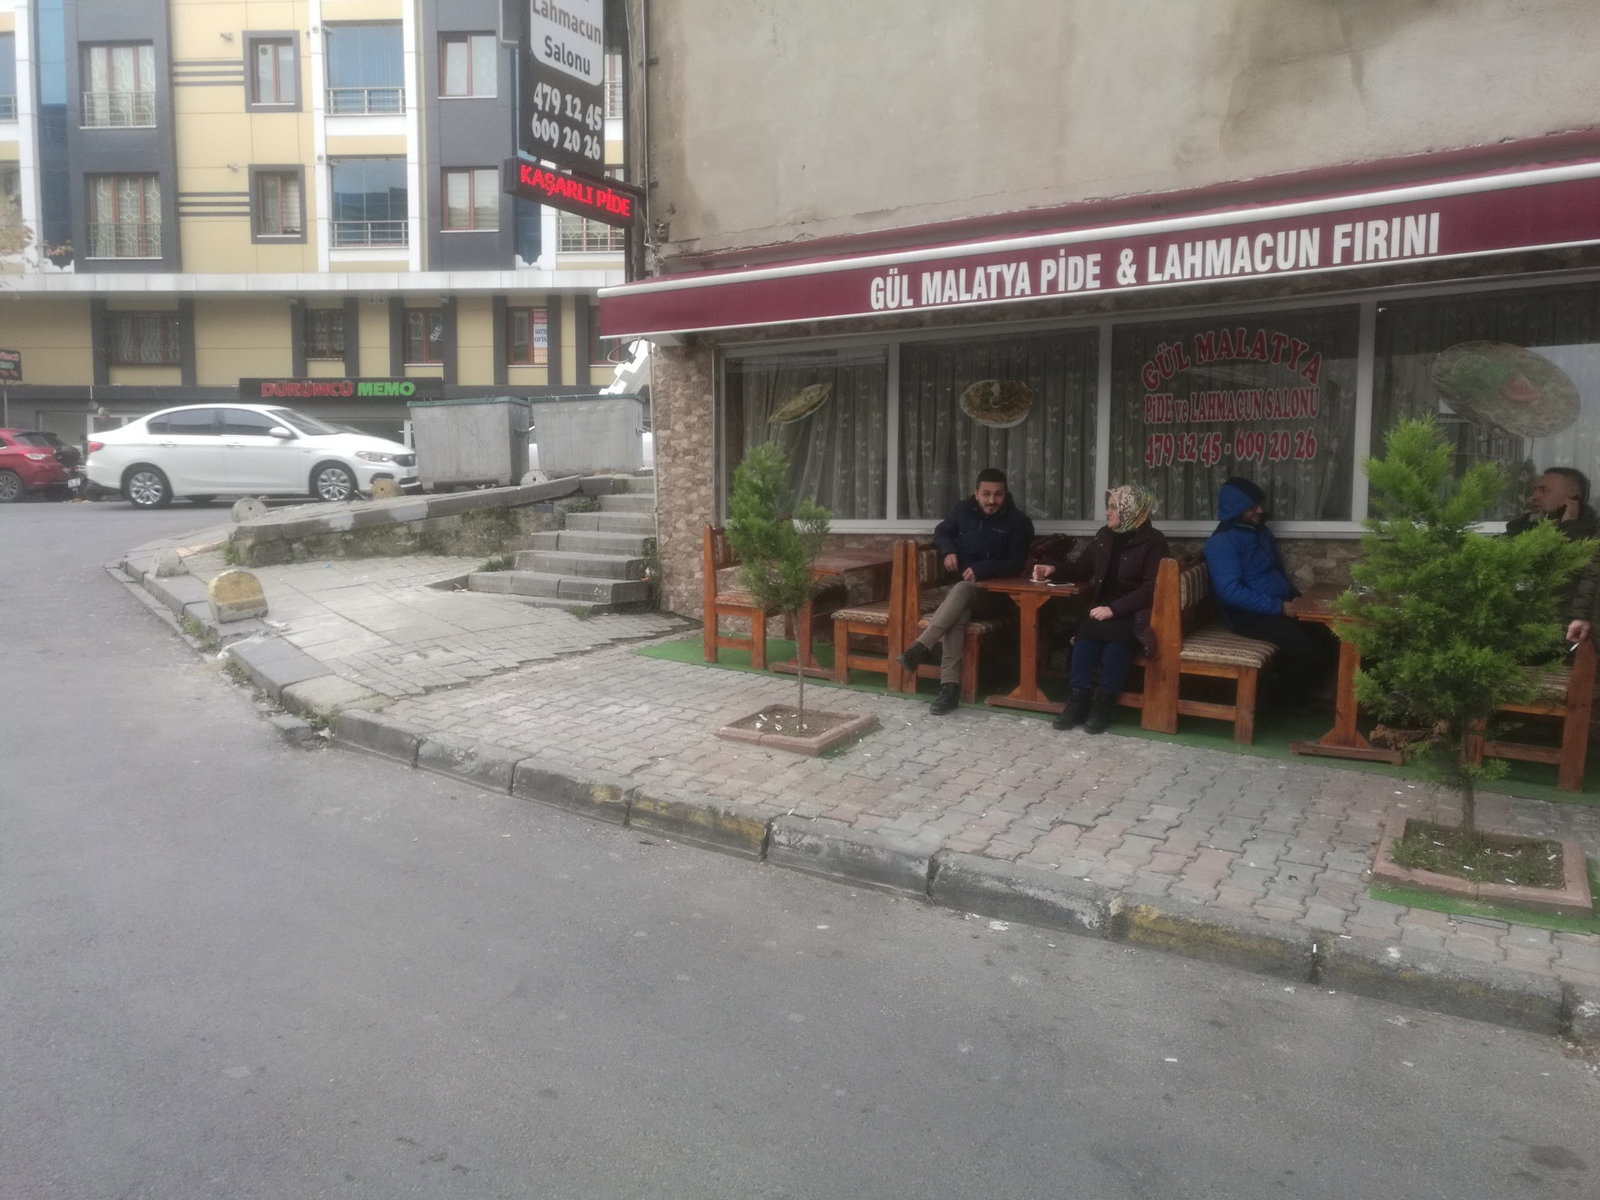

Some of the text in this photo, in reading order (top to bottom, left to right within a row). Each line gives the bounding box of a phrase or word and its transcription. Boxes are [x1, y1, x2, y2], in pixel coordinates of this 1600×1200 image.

[533, 0, 601, 76] Lahmacun Salonu
[533, 82, 602, 131] 479 12 45
[531, 113, 600, 161] 609 20 26
[520, 164, 631, 217] KAŞARLI PİDE
[870, 212, 1440, 310] GÜL MALATYA PİDE & LAHMACUN FIRINI
[1142, 328, 1322, 390] GÜL MALATYA
[261, 380, 416, 397] DÜRÜMCÜ MEMO
[1175, 400, 1188, 423] ve
[1190, 389, 1264, 423] LAHMACUN
[1265, 386, 1320, 420] SALONU
[1144, 433, 1174, 468] 479
[1176, 432, 1197, 462] 12
[1201, 432, 1222, 467] 45
[1234, 427, 1266, 465] 609
[1269, 430, 1291, 461] 20
[1294, 426, 1317, 461] 26
